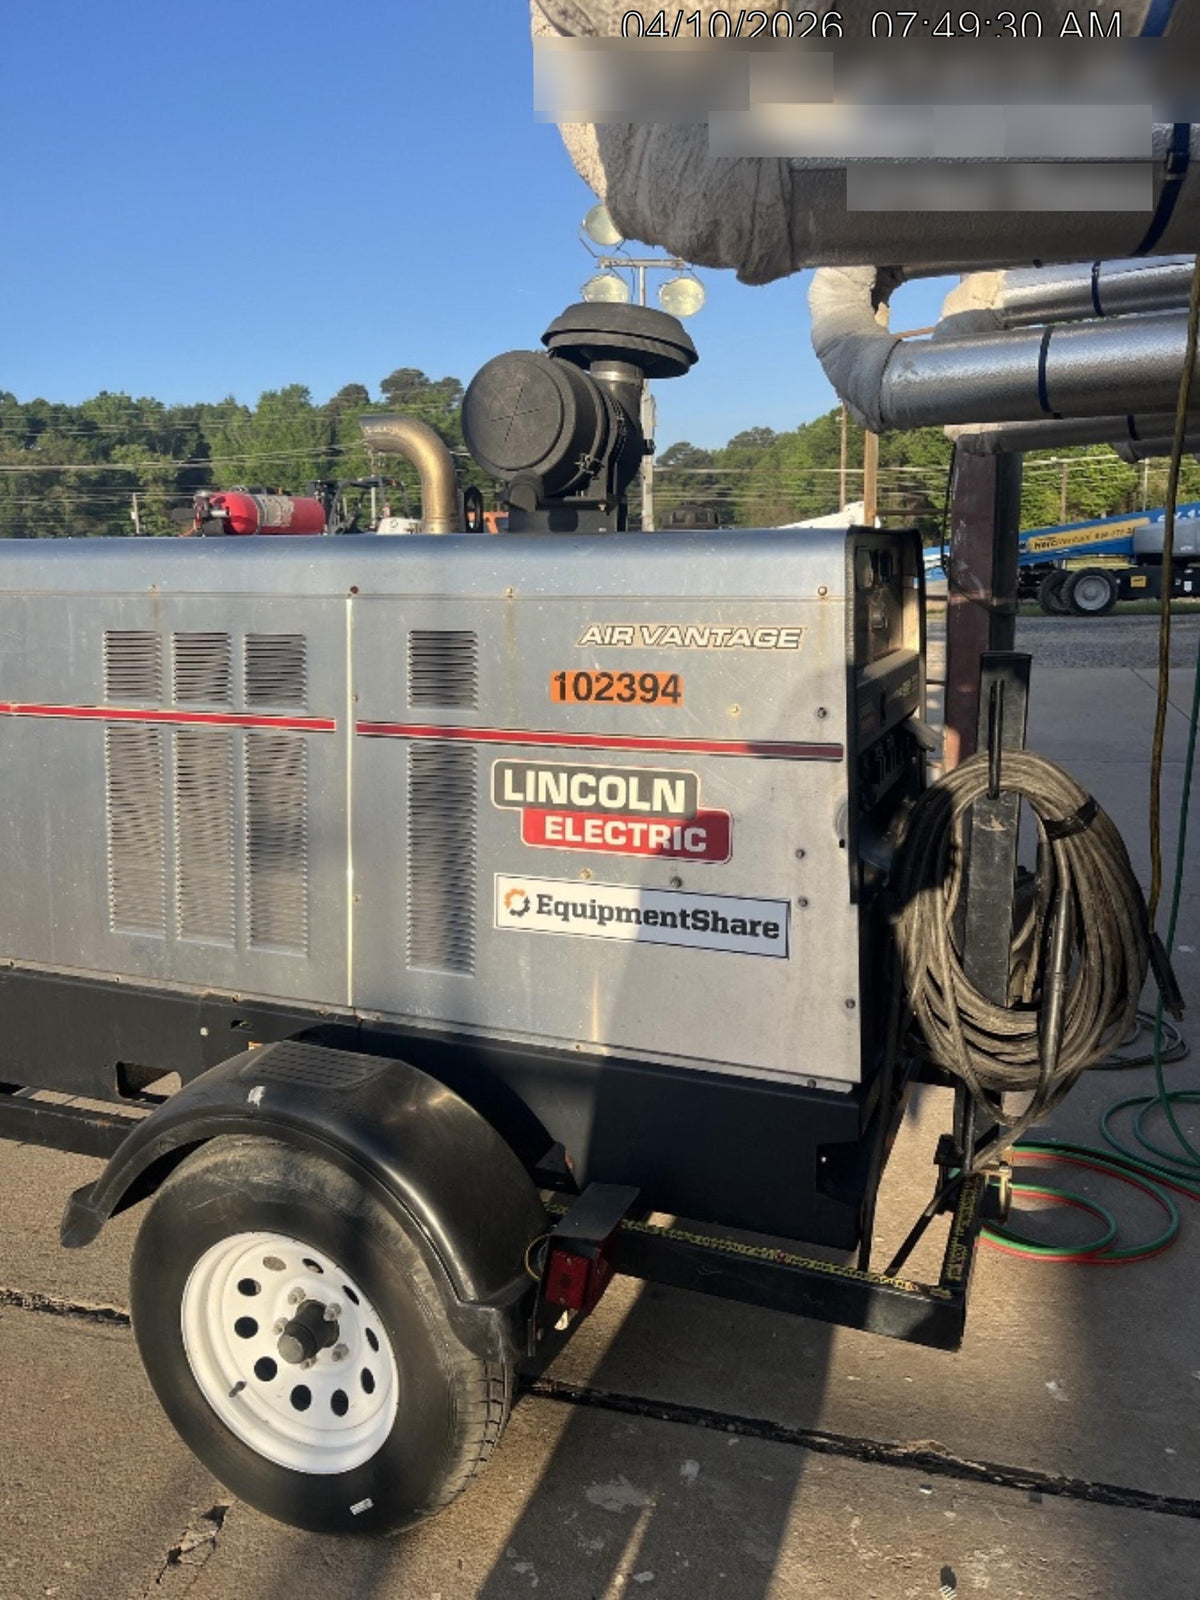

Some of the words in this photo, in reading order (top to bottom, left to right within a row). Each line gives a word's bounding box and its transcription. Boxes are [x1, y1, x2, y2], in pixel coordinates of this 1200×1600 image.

[577, 624, 634, 647] AIR
[640, 625, 803, 650] VANTAGE
[554, 671, 682, 703] 102394
[503, 768, 686, 814] LINCOLN
[544, 815, 707, 853] ELECTRIC
[536, 893, 780, 940] EquipmentShare
